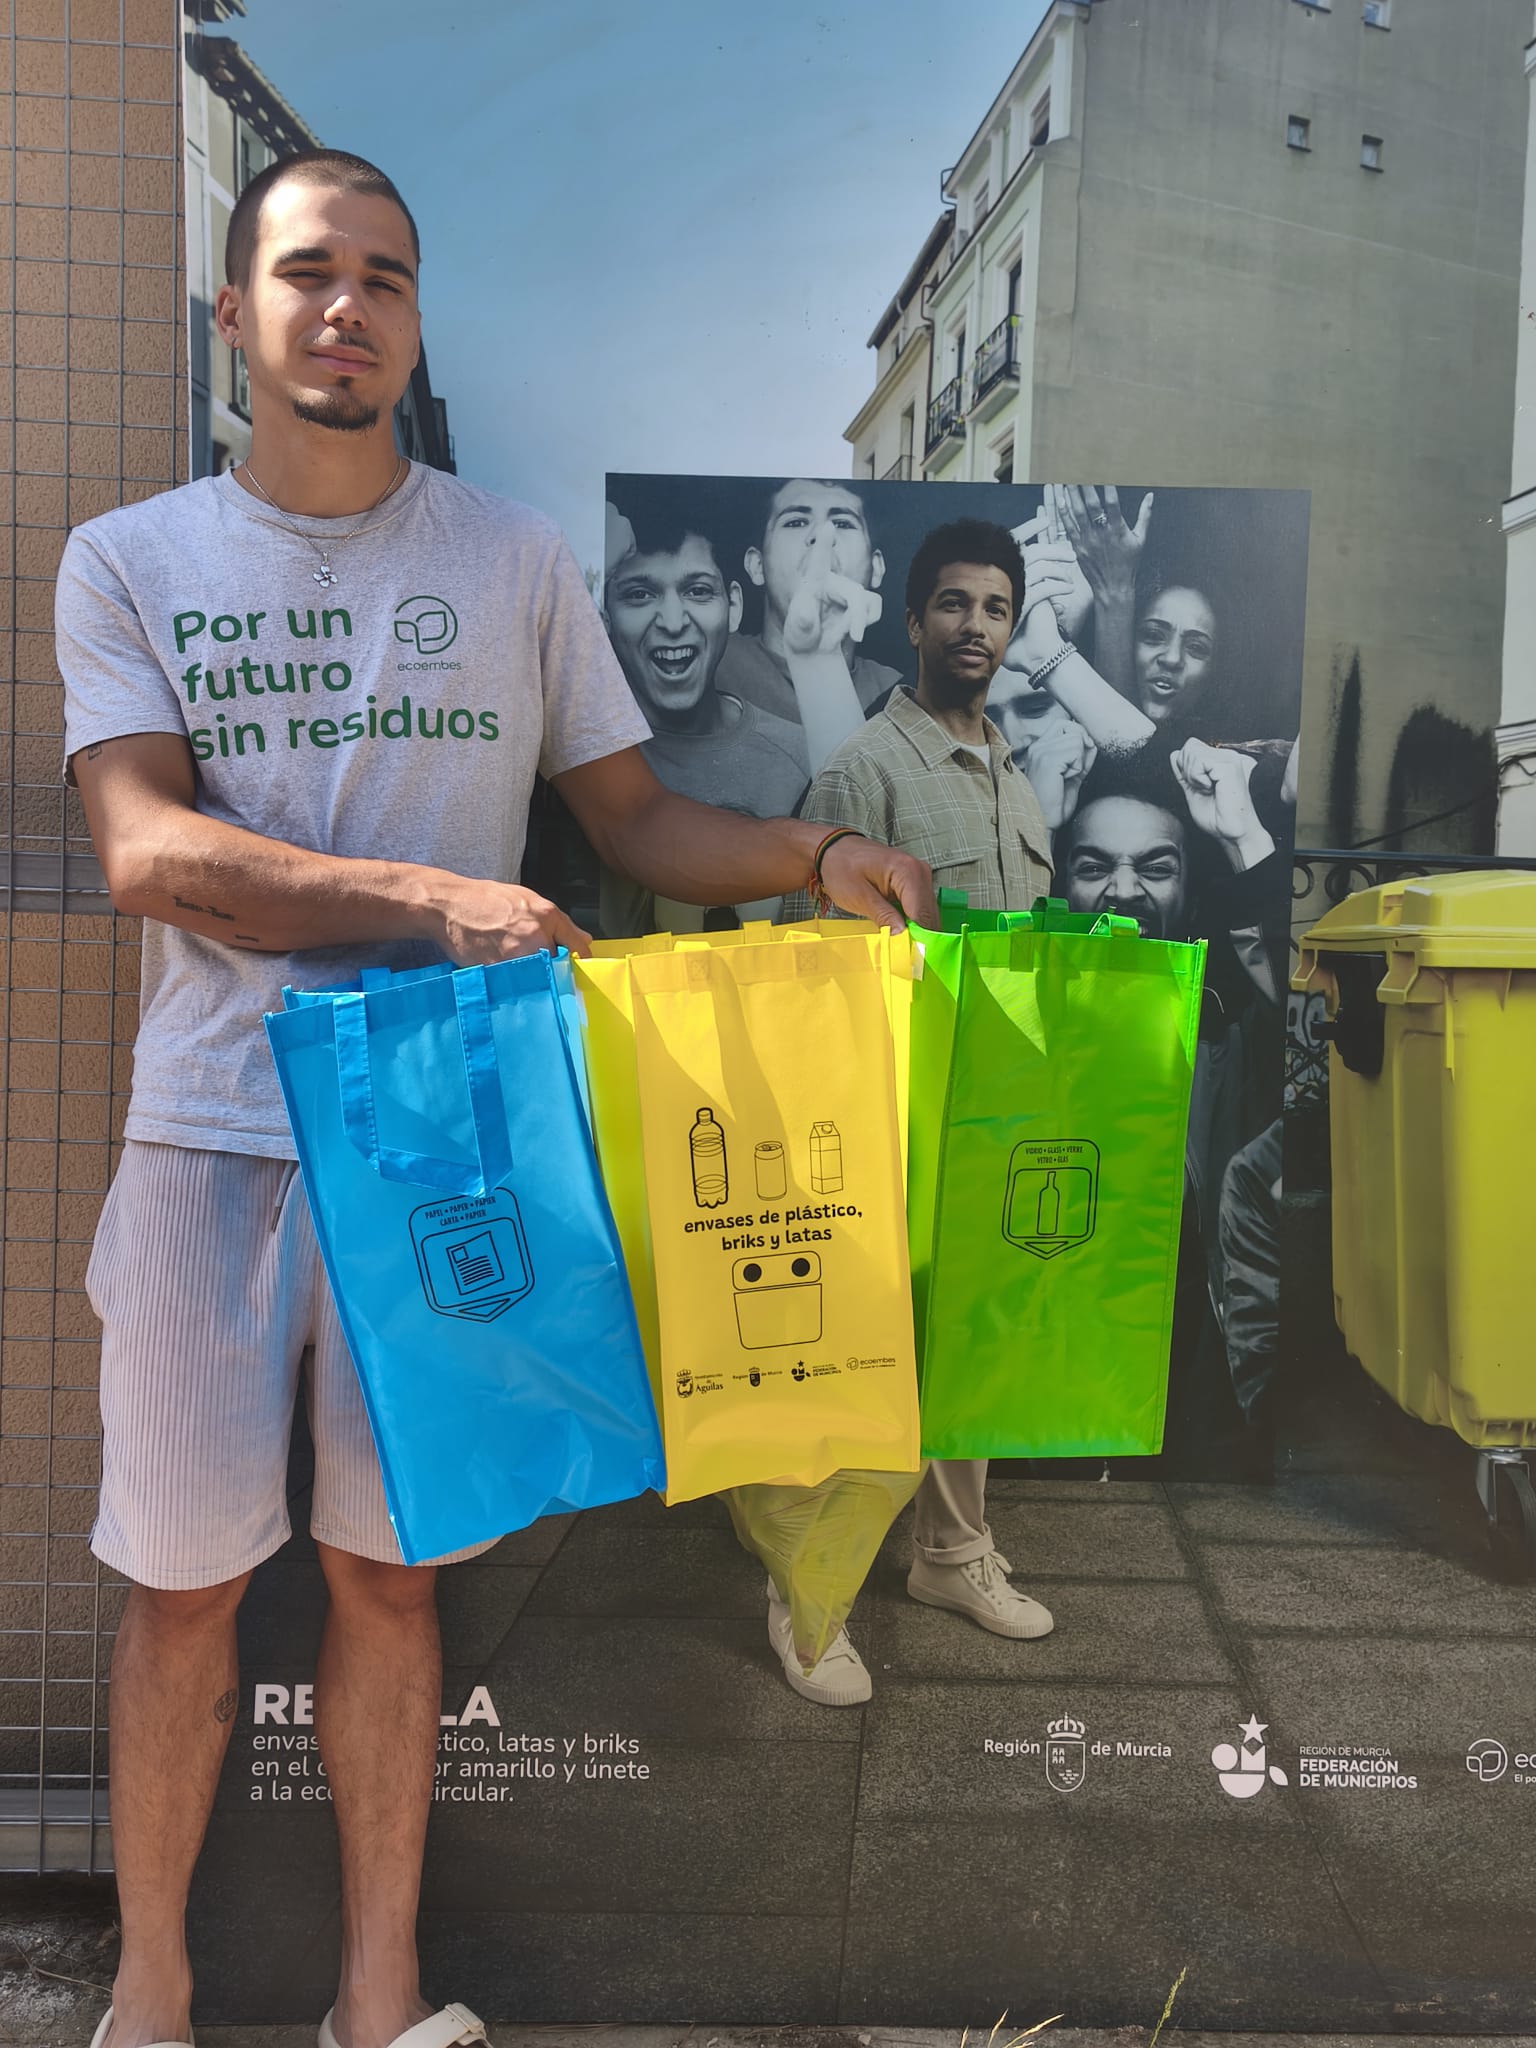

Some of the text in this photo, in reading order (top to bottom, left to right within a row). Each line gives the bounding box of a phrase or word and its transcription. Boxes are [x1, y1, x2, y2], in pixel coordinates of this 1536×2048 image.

[173, 608, 353, 654] Por un
[397, 660, 462, 672] ecoembes
[181, 656, 352, 703] futuro
[190, 695, 499, 761] sin residuos
[684, 1204, 863, 1233] envases de plástico,
[721, 1228, 833, 1251] briks y latas
[499, 1732, 556, 1753] latas
[563, 1738, 576, 1758] y
[584, 1733, 640, 1754] briks
[984, 1739, 1172, 1758] Región de Murcia
[1338, 1747, 1351, 1756] DE
[1353, 1747, 1392, 1757] MURCIA
[251, 1761, 280, 1777] en
[287, 1755, 310, 1777] el
[459, 1757, 556, 1779] amarillo
[563, 1763, 576, 1783] y
[584, 1757, 650, 1780] únete
[1300, 1757, 1399, 1774] FEDERACIÓN
[1300, 1774, 1418, 1789] DE MUNICIPIOS
[1514, 1774, 1524, 1783] El
[250, 1785, 263, 1801] a
[272, 1780, 293, 1801] la
[431, 1780, 514, 1802] ircular.
